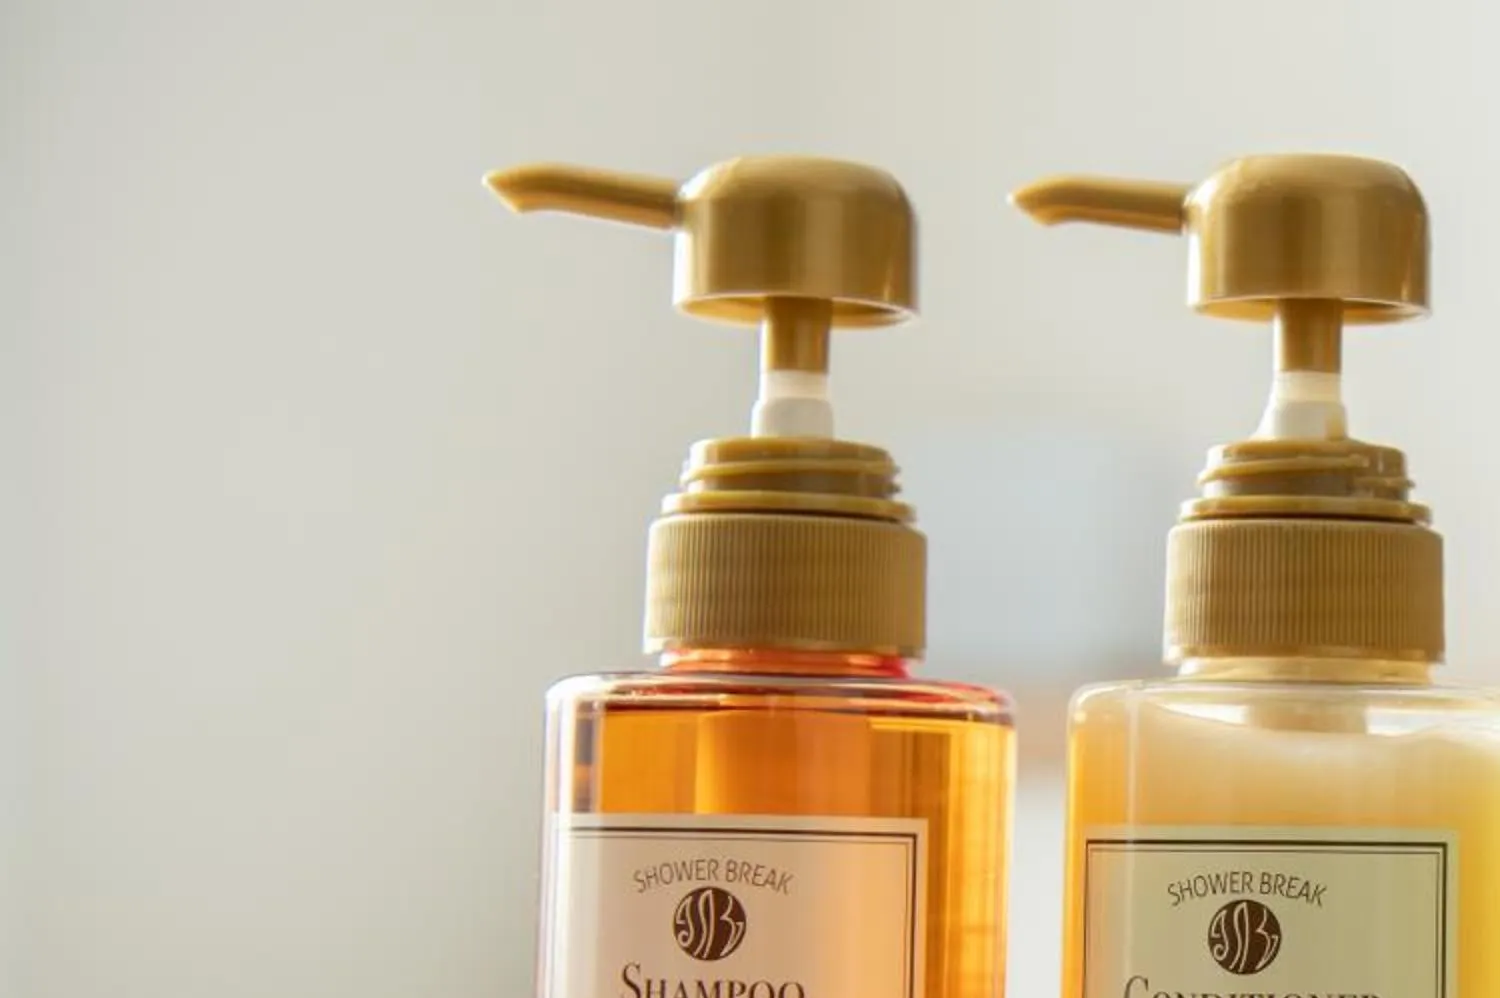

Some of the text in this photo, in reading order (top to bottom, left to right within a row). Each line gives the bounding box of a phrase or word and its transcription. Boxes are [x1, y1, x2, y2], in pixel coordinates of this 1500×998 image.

[633, 859, 794, 895] SHOWER BREAK
[1167, 872, 1327, 906] SHOWER BREAK
